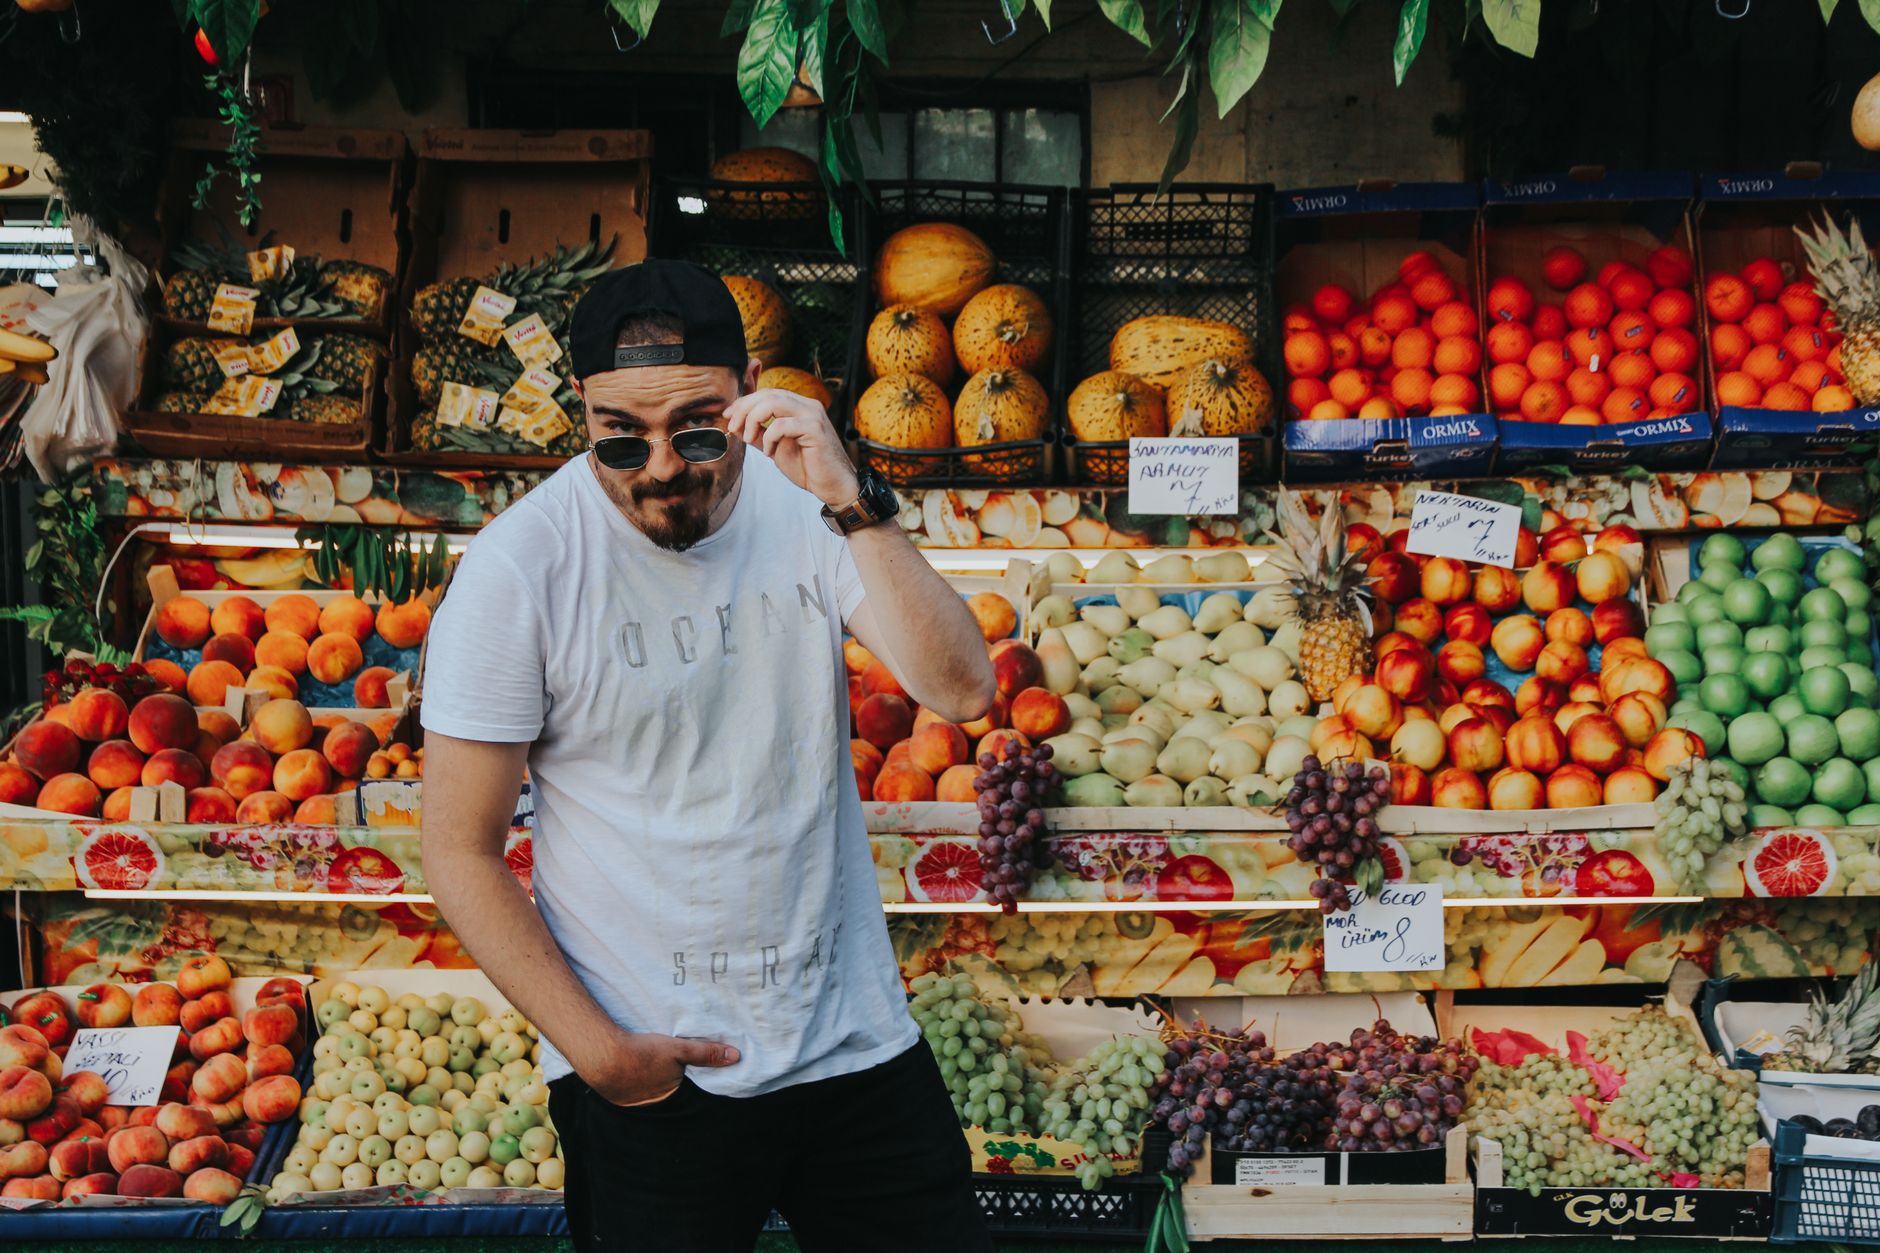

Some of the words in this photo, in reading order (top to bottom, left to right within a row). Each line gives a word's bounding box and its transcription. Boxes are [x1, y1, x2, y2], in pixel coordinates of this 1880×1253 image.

[1503, 180, 1556, 197] ORMIX
[1719, 179, 1773, 194] ORMIX
[1294, 195, 1347, 211] ORMIX
[1423, 419, 1479, 439] ORMIX
[1633, 417, 1691, 437] ORMIX
[1804, 435, 1860, 444] Turkey
[1363, 453, 1418, 463] Turkey
[1574, 450, 1632, 460] Turkey
[620, 573, 828, 668] OCEAN
[1382, 916, 1411, 963] 8
